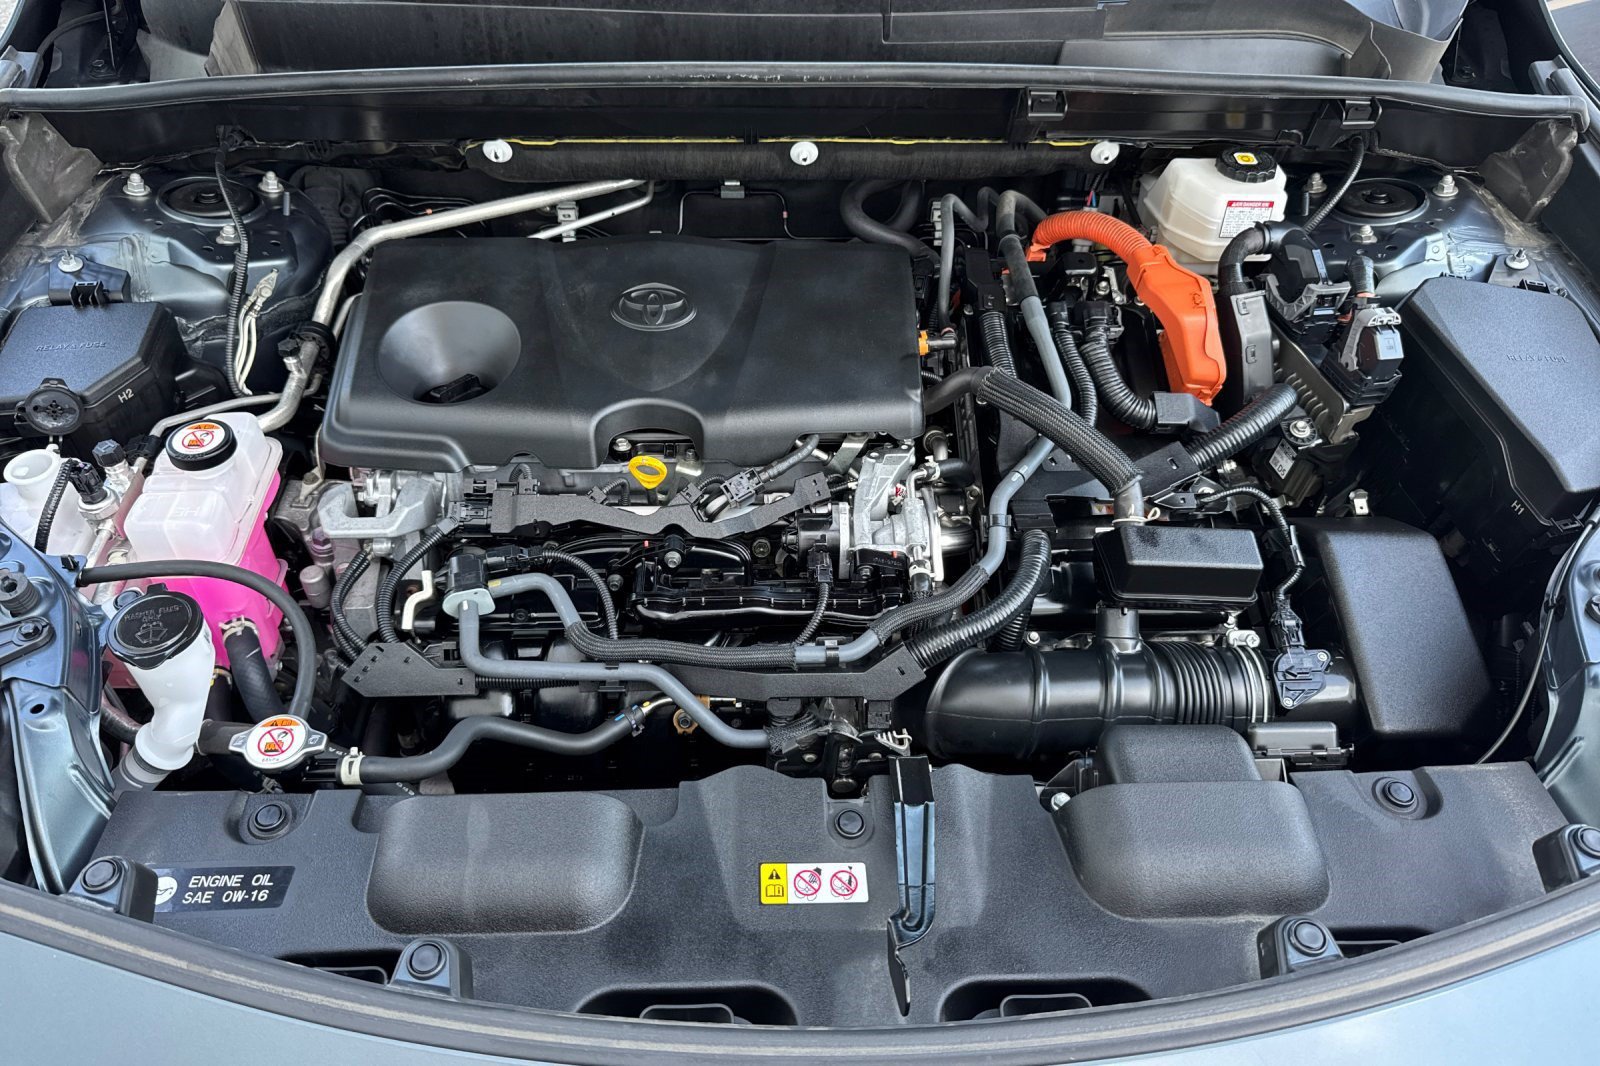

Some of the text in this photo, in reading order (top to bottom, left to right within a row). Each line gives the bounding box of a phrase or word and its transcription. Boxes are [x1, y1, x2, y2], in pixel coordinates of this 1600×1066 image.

[35, 343, 68, 352] RELAY
[79, 341, 107, 349] FUSE
[117, 388, 134, 403] H2
[1511, 500, 1525, 515] H1
[188, 874, 274, 888] ENGINE OIL
[182, 889, 269, 904] SAE 0W-16
